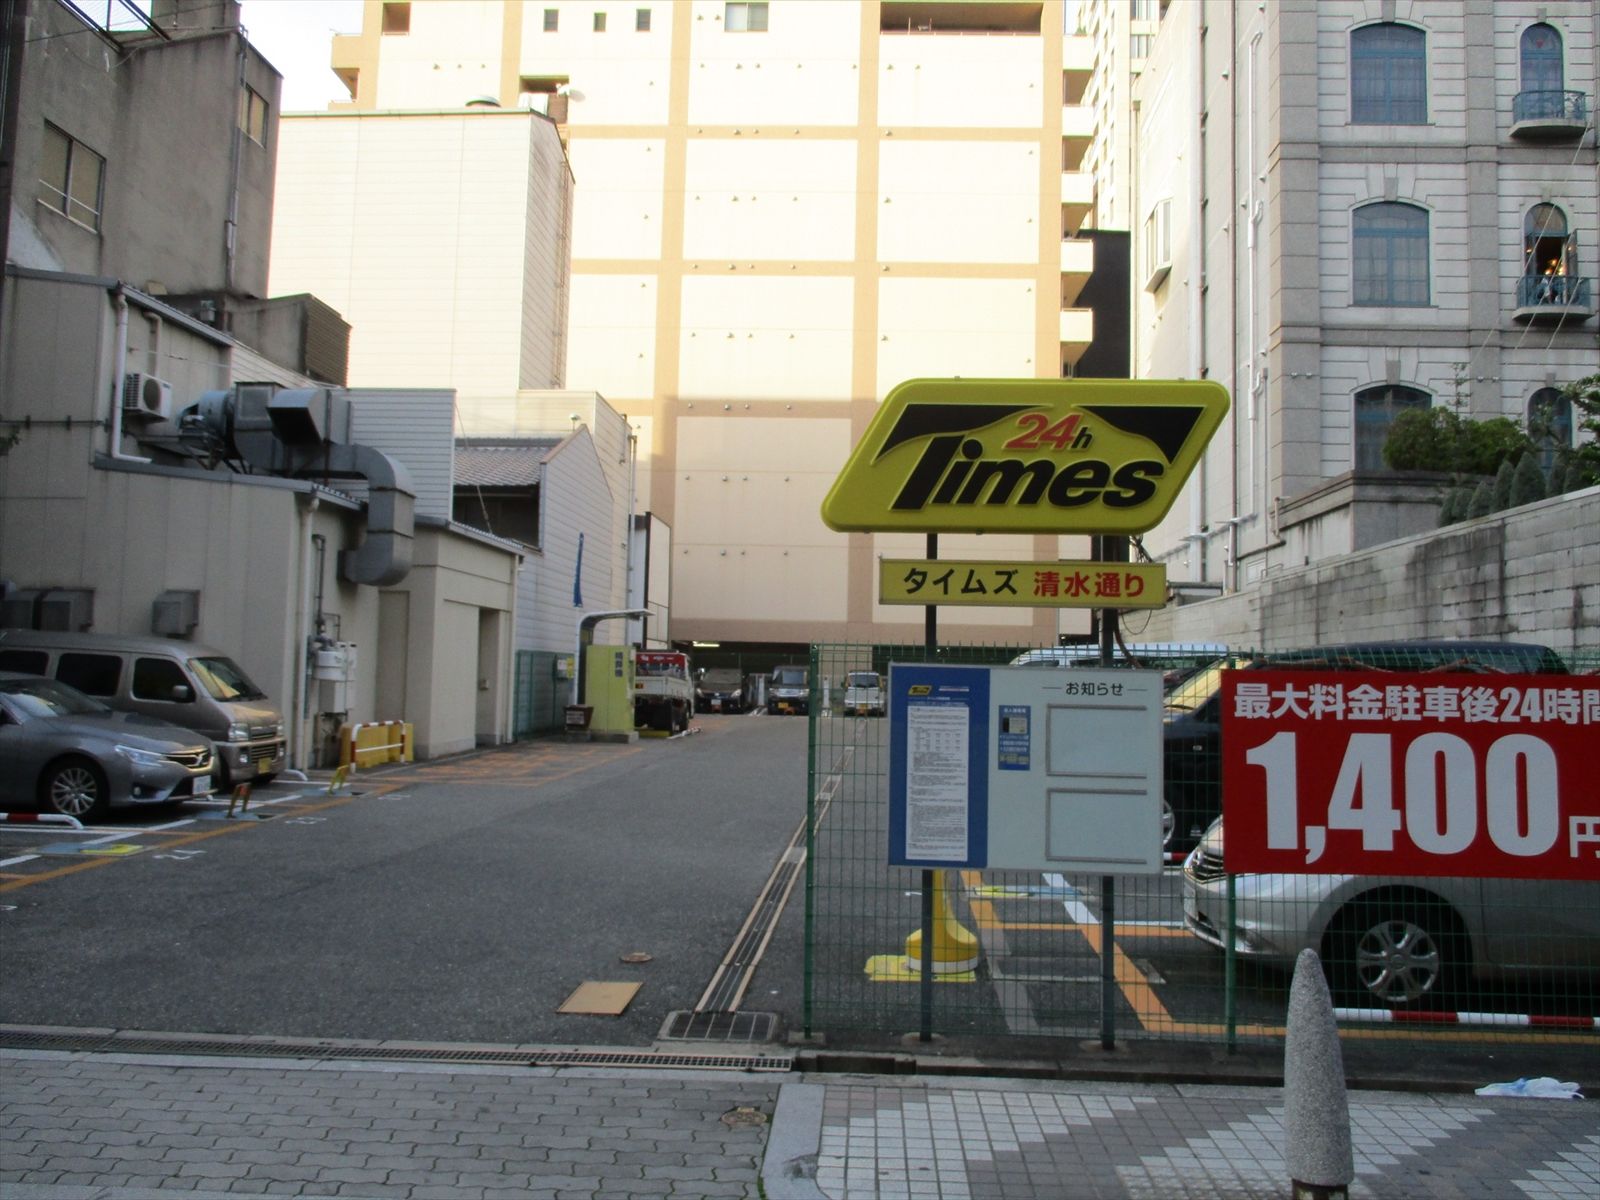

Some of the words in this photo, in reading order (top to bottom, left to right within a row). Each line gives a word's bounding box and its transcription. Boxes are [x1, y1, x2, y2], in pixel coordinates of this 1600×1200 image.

[1006, 413, 1093, 450] 24h
[890, 434, 1164, 511] Times
[903, 567, 1019, 596] タイムズ
[1032, 571, 1145, 598] 清水通り
[1065, 681, 1124, 697] お知らせ
